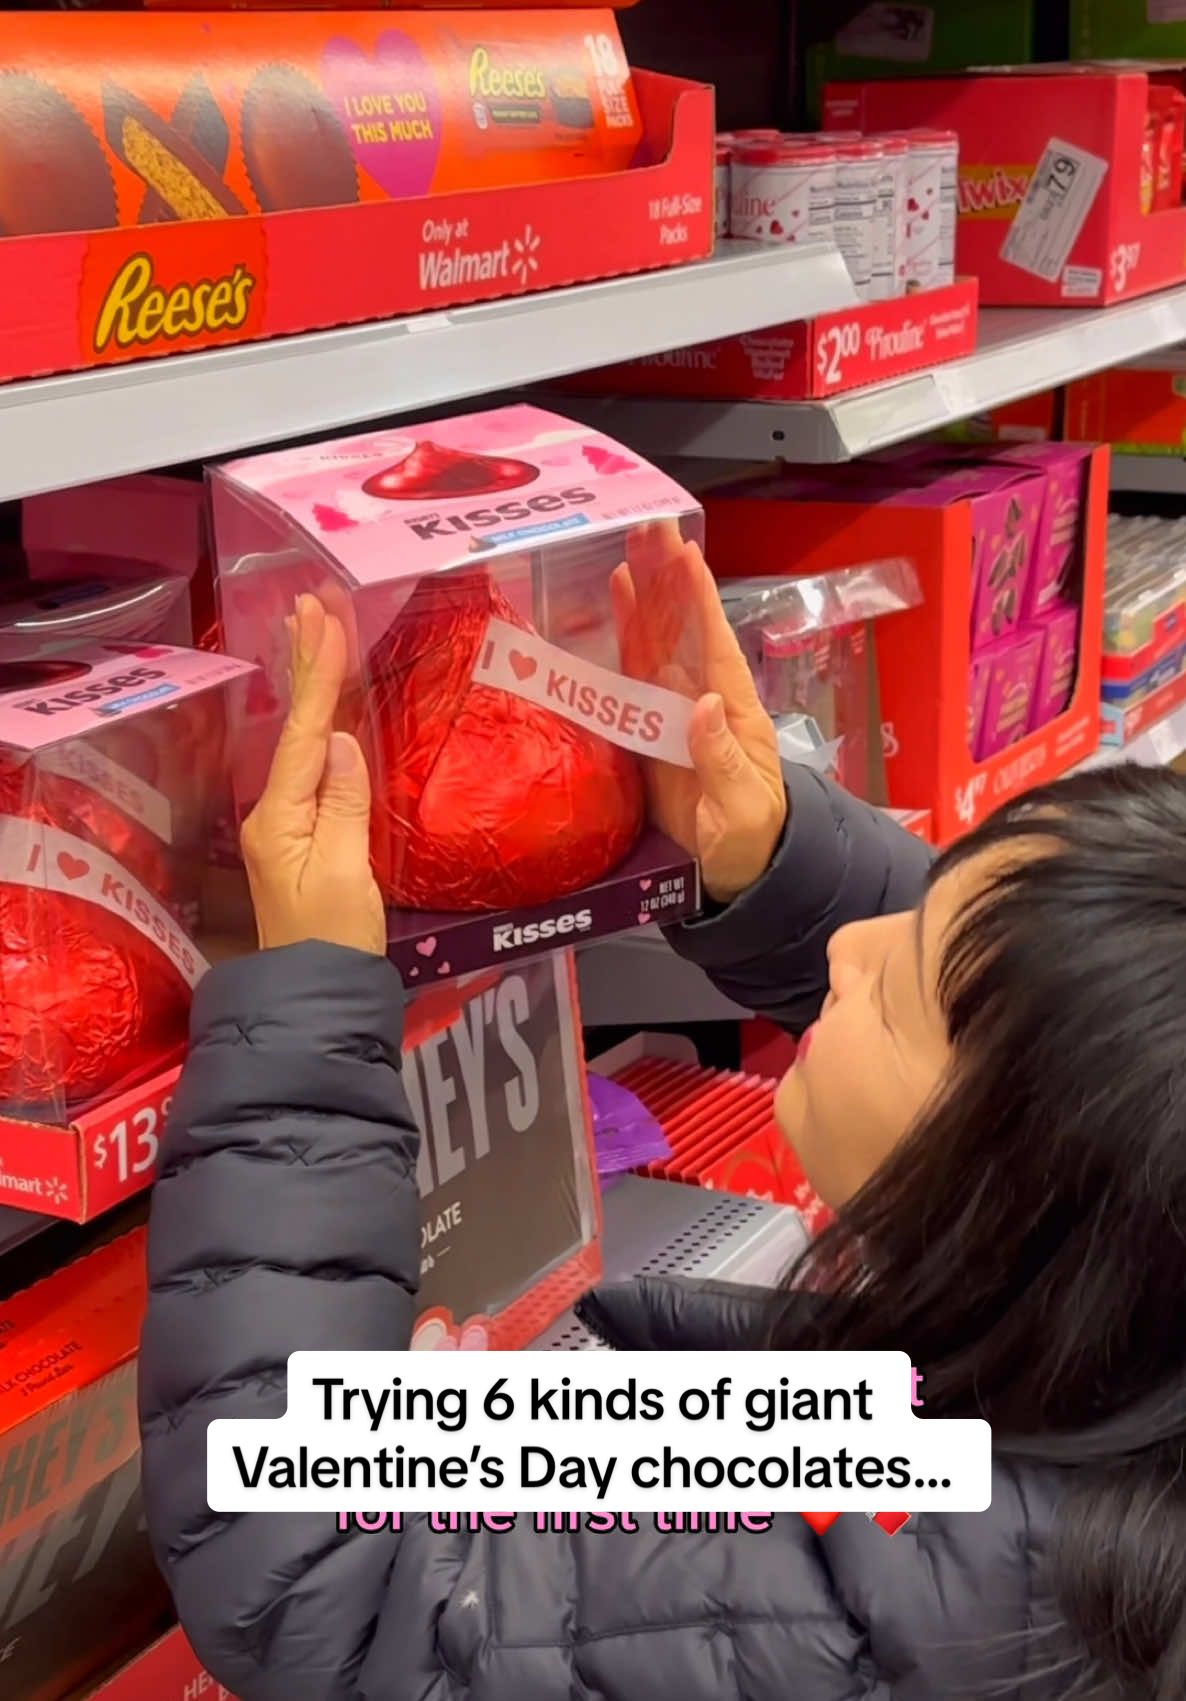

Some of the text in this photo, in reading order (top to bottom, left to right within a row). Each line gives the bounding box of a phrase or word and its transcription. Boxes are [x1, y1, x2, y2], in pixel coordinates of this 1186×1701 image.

[343, 89, 427, 117] I LOVE YOU
[351, 119, 433, 144] THIS MUCH
[422, 218, 469, 246] Only at
[419, 240, 509, 290] Walmart
[93, 253, 256, 353] Reese's
[481, 640, 664, 742] I KISSES
[26, 844, 195, 976] I KISSES
